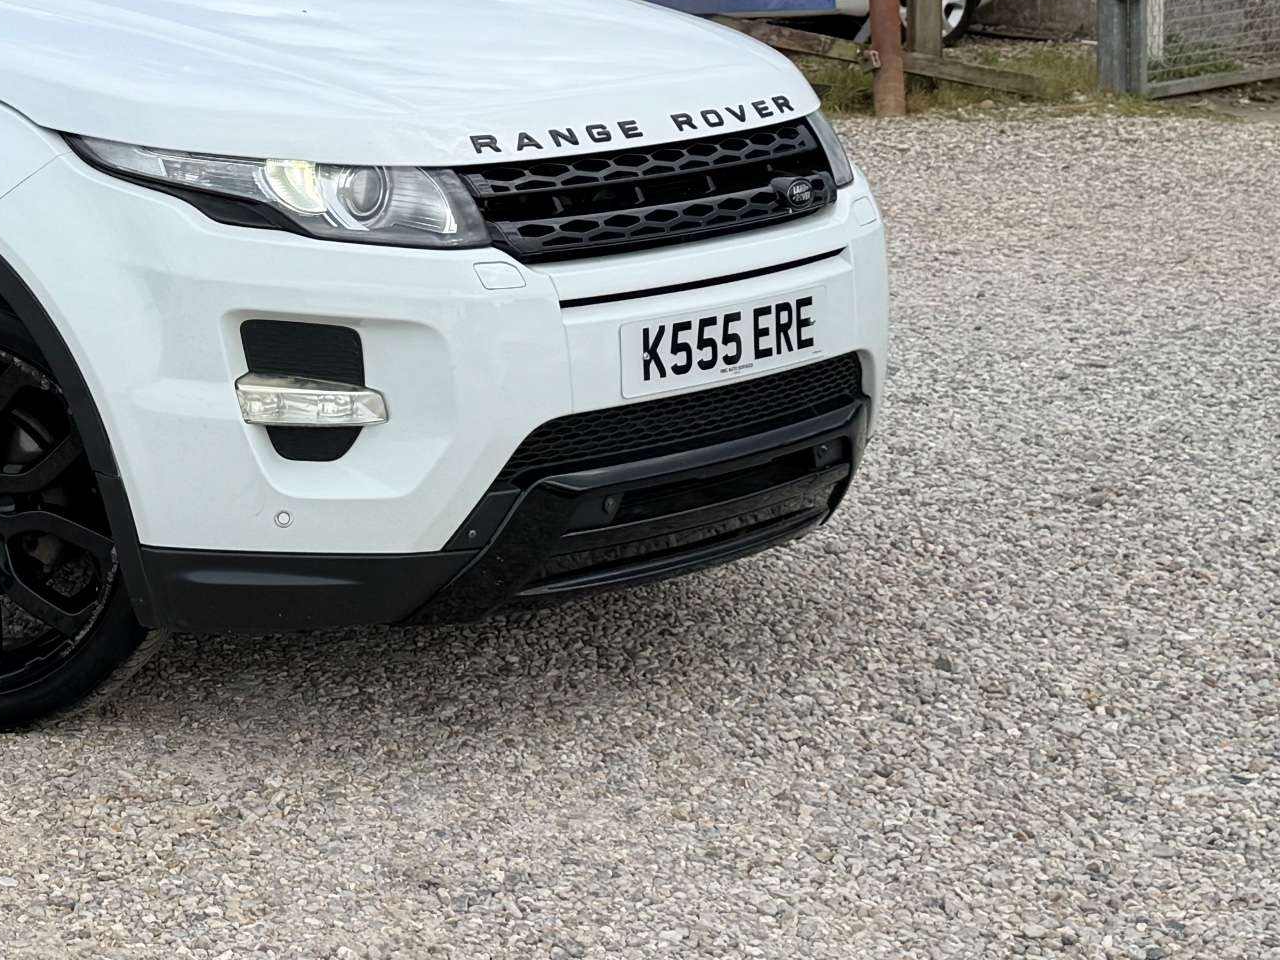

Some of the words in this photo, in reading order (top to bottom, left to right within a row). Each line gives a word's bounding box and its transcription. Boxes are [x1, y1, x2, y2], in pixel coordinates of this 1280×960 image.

[470, 120, 643, 154] RANGE
[671, 95, 795, 132] ROVER
[642, 311, 742, 381] K555
[753, 296, 814, 360] ERE
